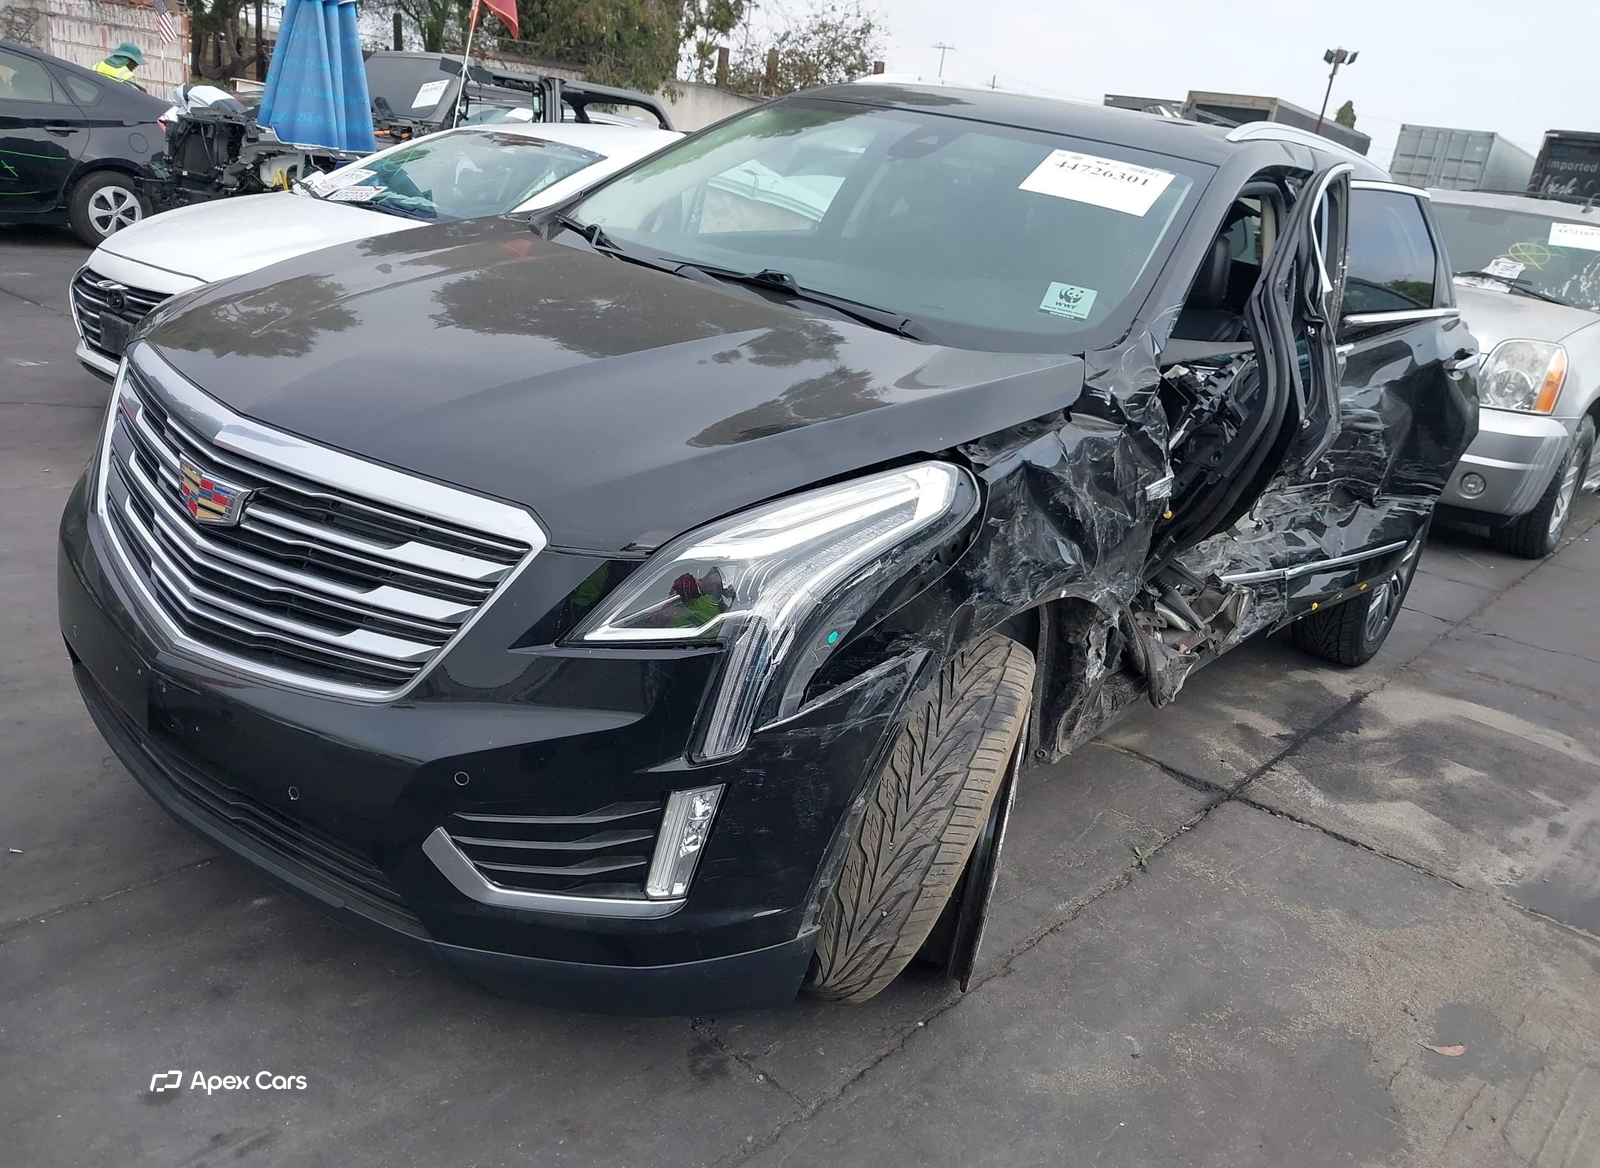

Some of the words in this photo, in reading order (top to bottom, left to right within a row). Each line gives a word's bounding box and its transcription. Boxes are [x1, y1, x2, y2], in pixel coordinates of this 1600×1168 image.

[1546, 160, 1598, 172] imported
[1055, 161, 1149, 185] 44726301
[1055, 301, 1078, 310] WWF
